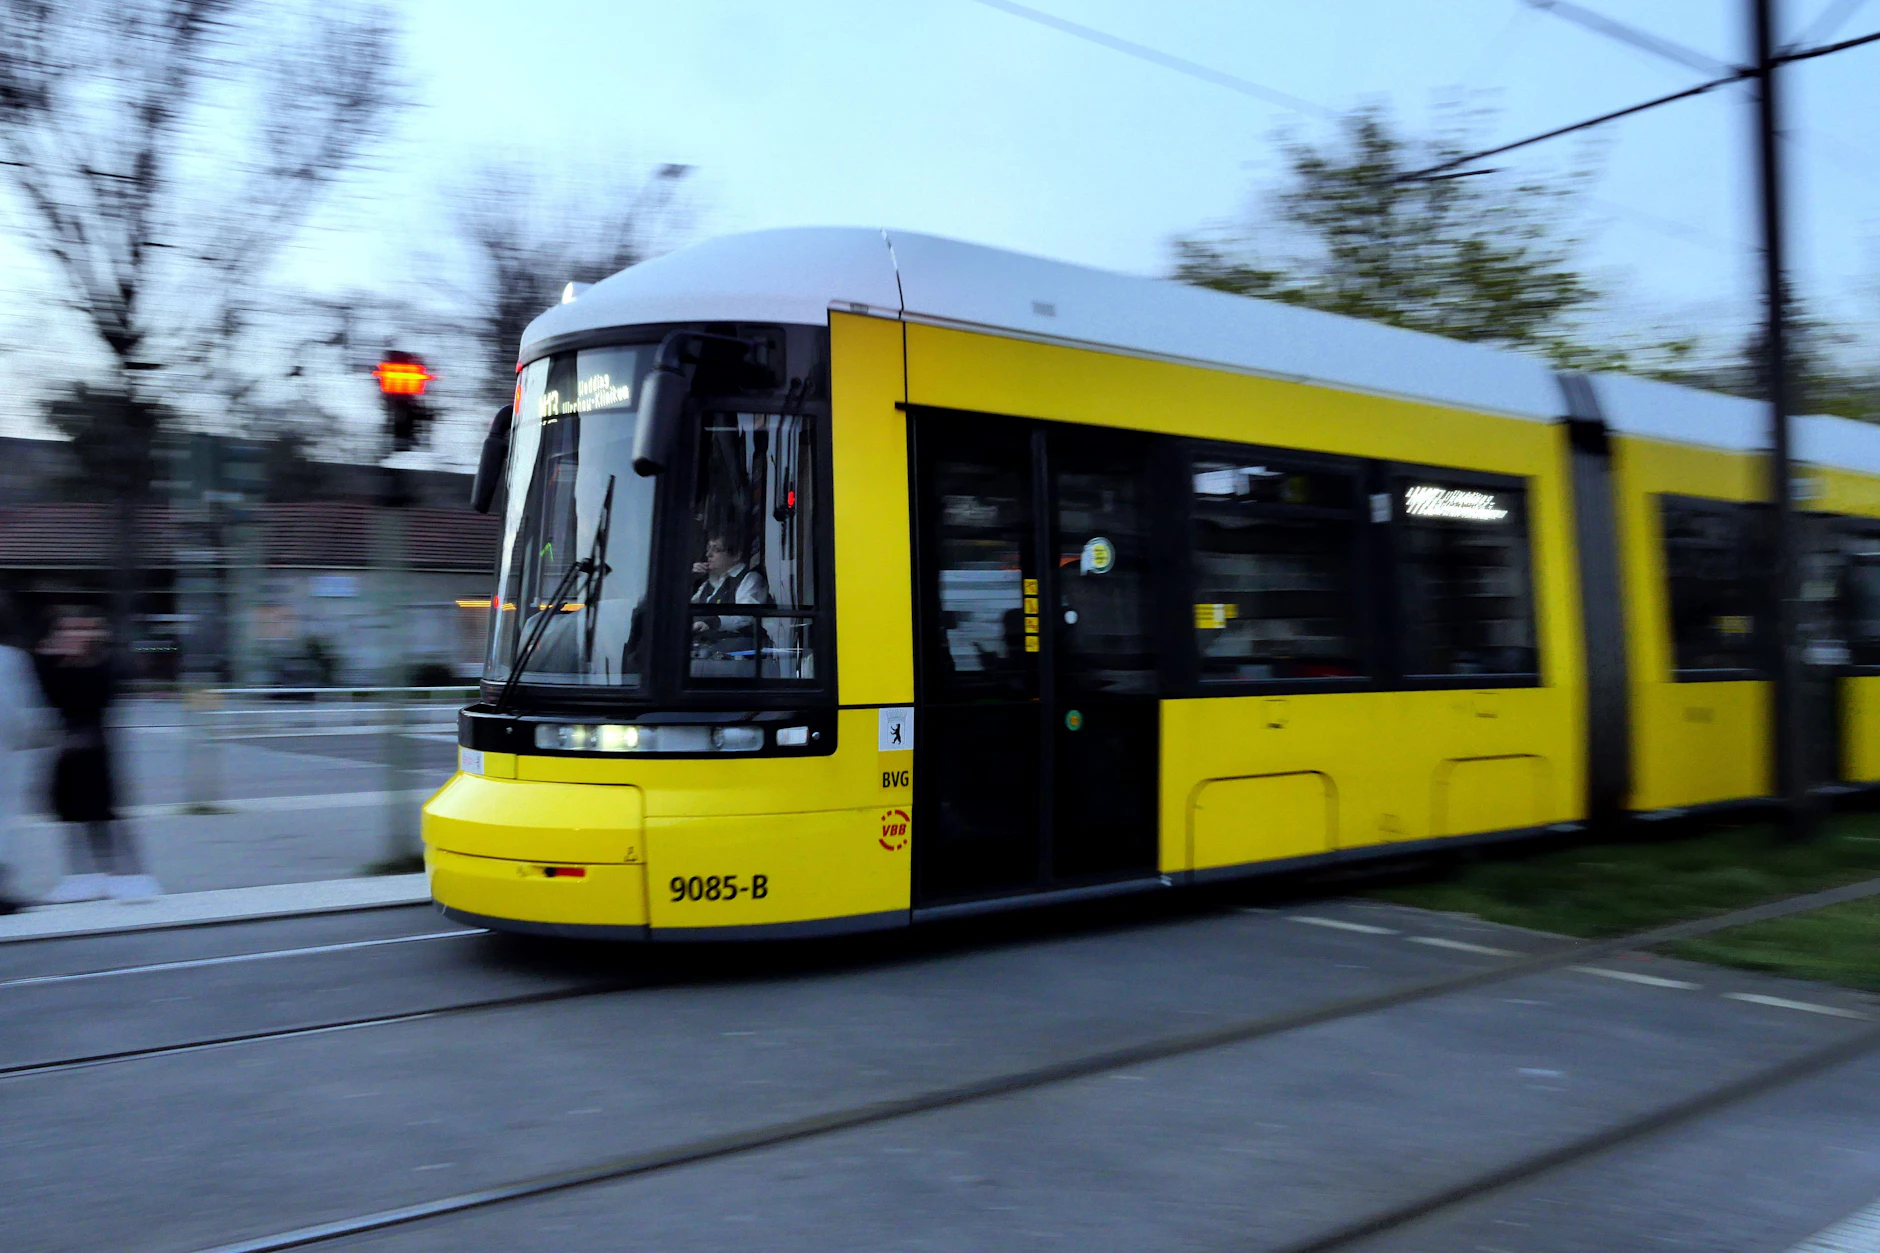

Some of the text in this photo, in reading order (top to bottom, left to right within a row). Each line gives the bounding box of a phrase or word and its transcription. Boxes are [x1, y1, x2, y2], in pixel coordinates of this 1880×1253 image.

[882, 771, 909, 788] BVG
[882, 823, 907, 837] VBB
[670, 874, 769, 902] 9085-B
